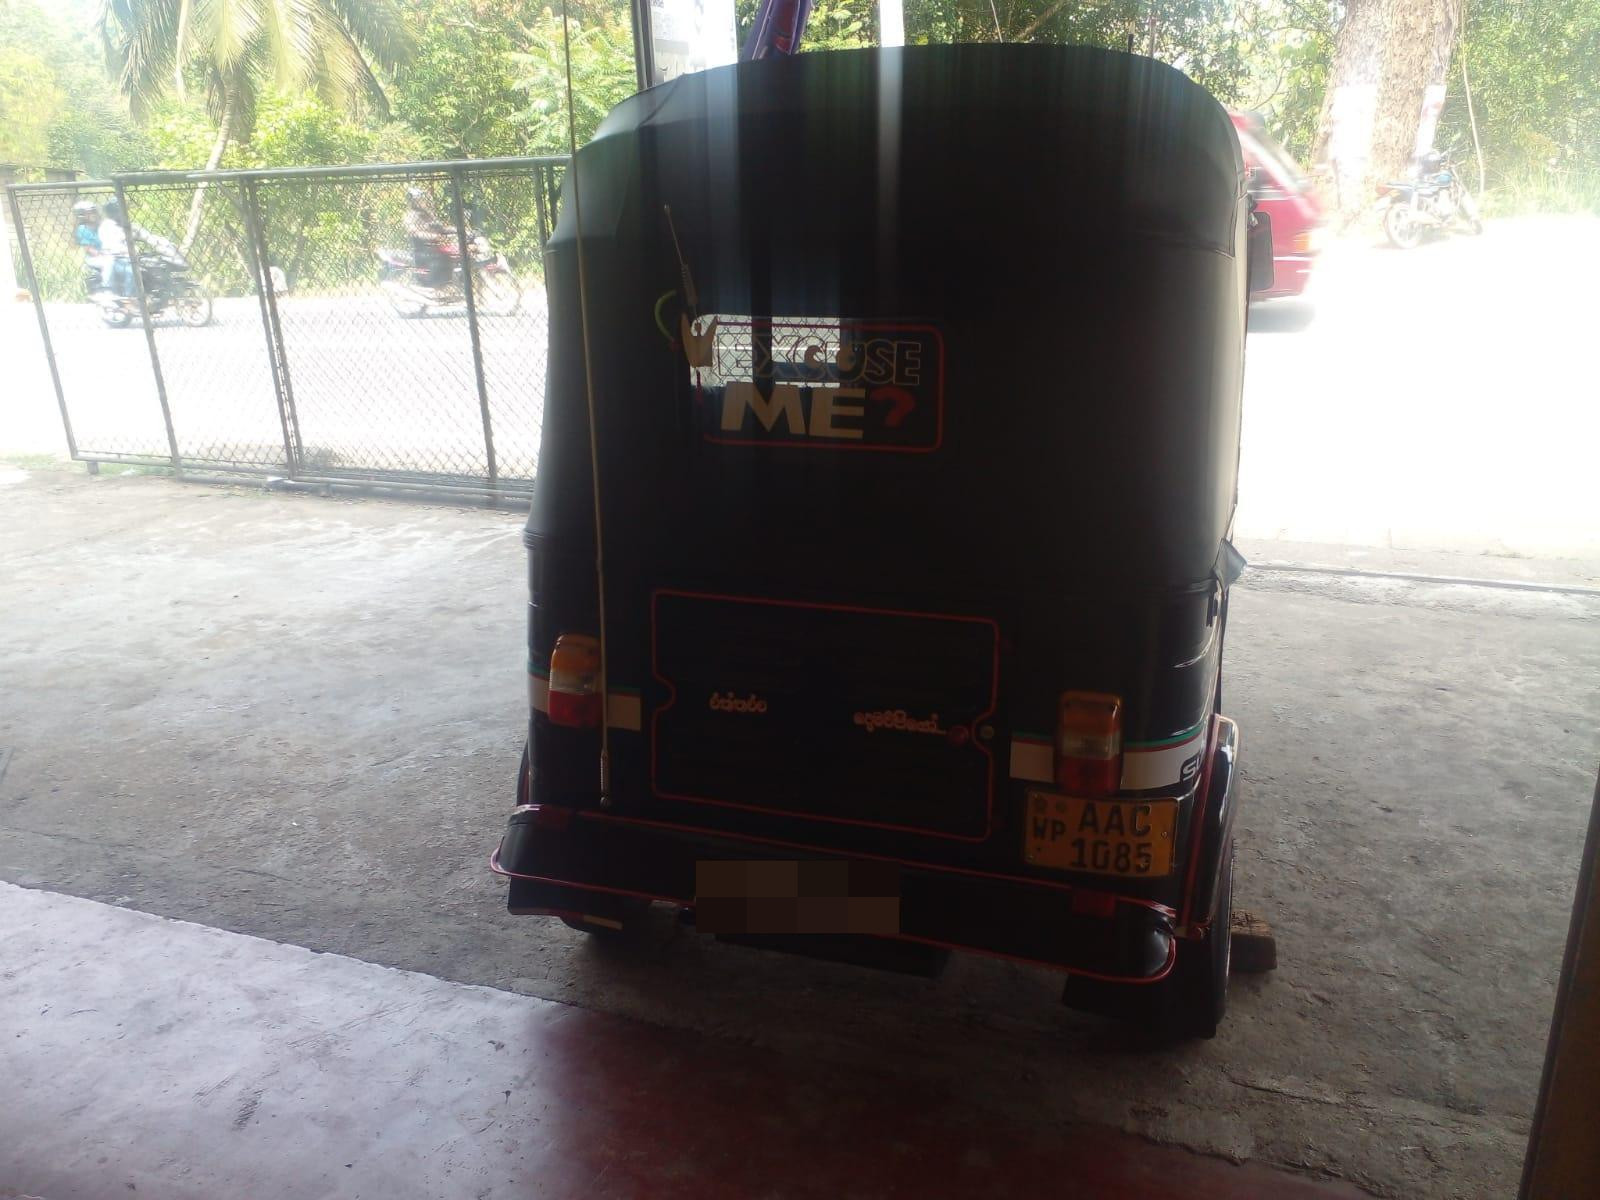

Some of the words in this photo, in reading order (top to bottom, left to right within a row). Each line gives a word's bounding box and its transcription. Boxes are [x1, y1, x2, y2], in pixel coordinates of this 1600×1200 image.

[717, 333, 921, 386] EXCUSE
[720, 381, 916, 439] ME?
[1033, 816, 1066, 842] WP
[1078, 802, 1152, 838] AAC
[1070, 838, 1153, 873] 1085
